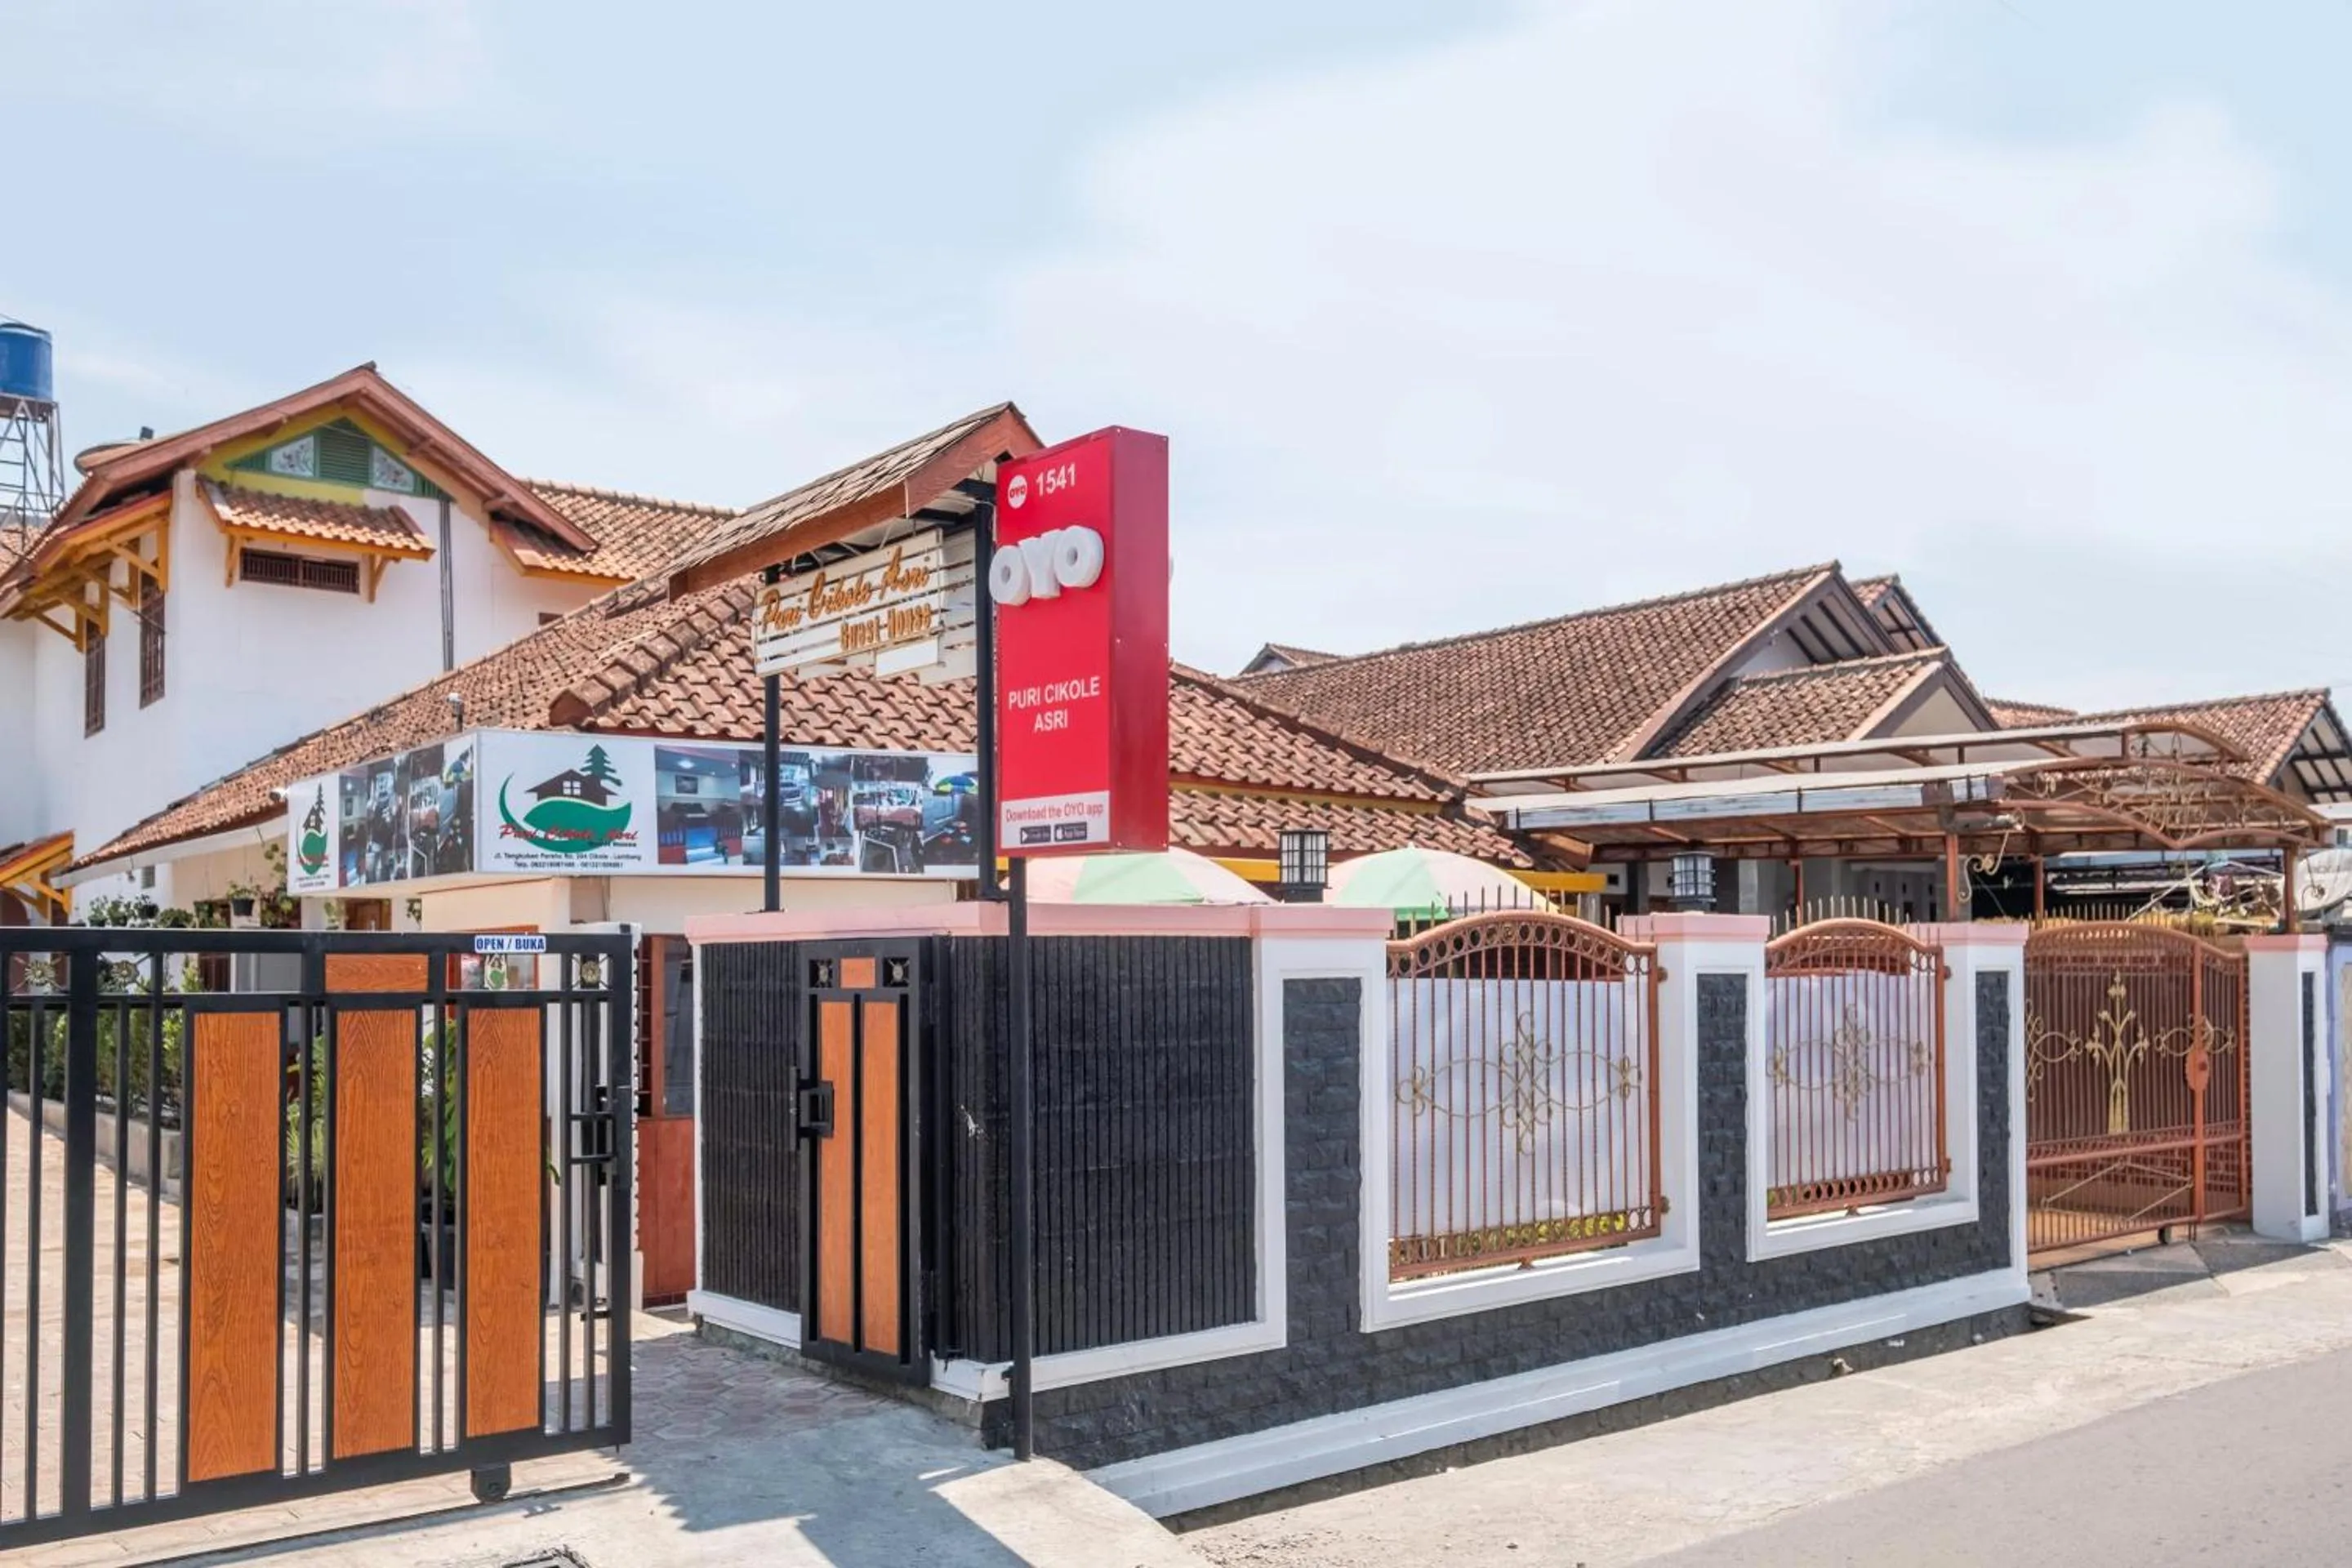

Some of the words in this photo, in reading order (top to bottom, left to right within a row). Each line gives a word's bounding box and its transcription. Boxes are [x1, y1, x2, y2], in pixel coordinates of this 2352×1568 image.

[1036, 462, 1076, 497] 1541
[988, 524, 1104, 606] OYO
[1008, 686, 1041, 710] PURI
[1045, 675, 1101, 704] CIKOLE
[1033, 707, 1069, 733] ASRI
[1005, 806, 1046, 822] Download
[1048, 804, 1062, 818] the
[1064, 801, 1085, 817] OYO
[1086, 803, 1103, 817] app
[476, 938, 505, 950] OPEN
[514, 938, 545, 950] BUKA
